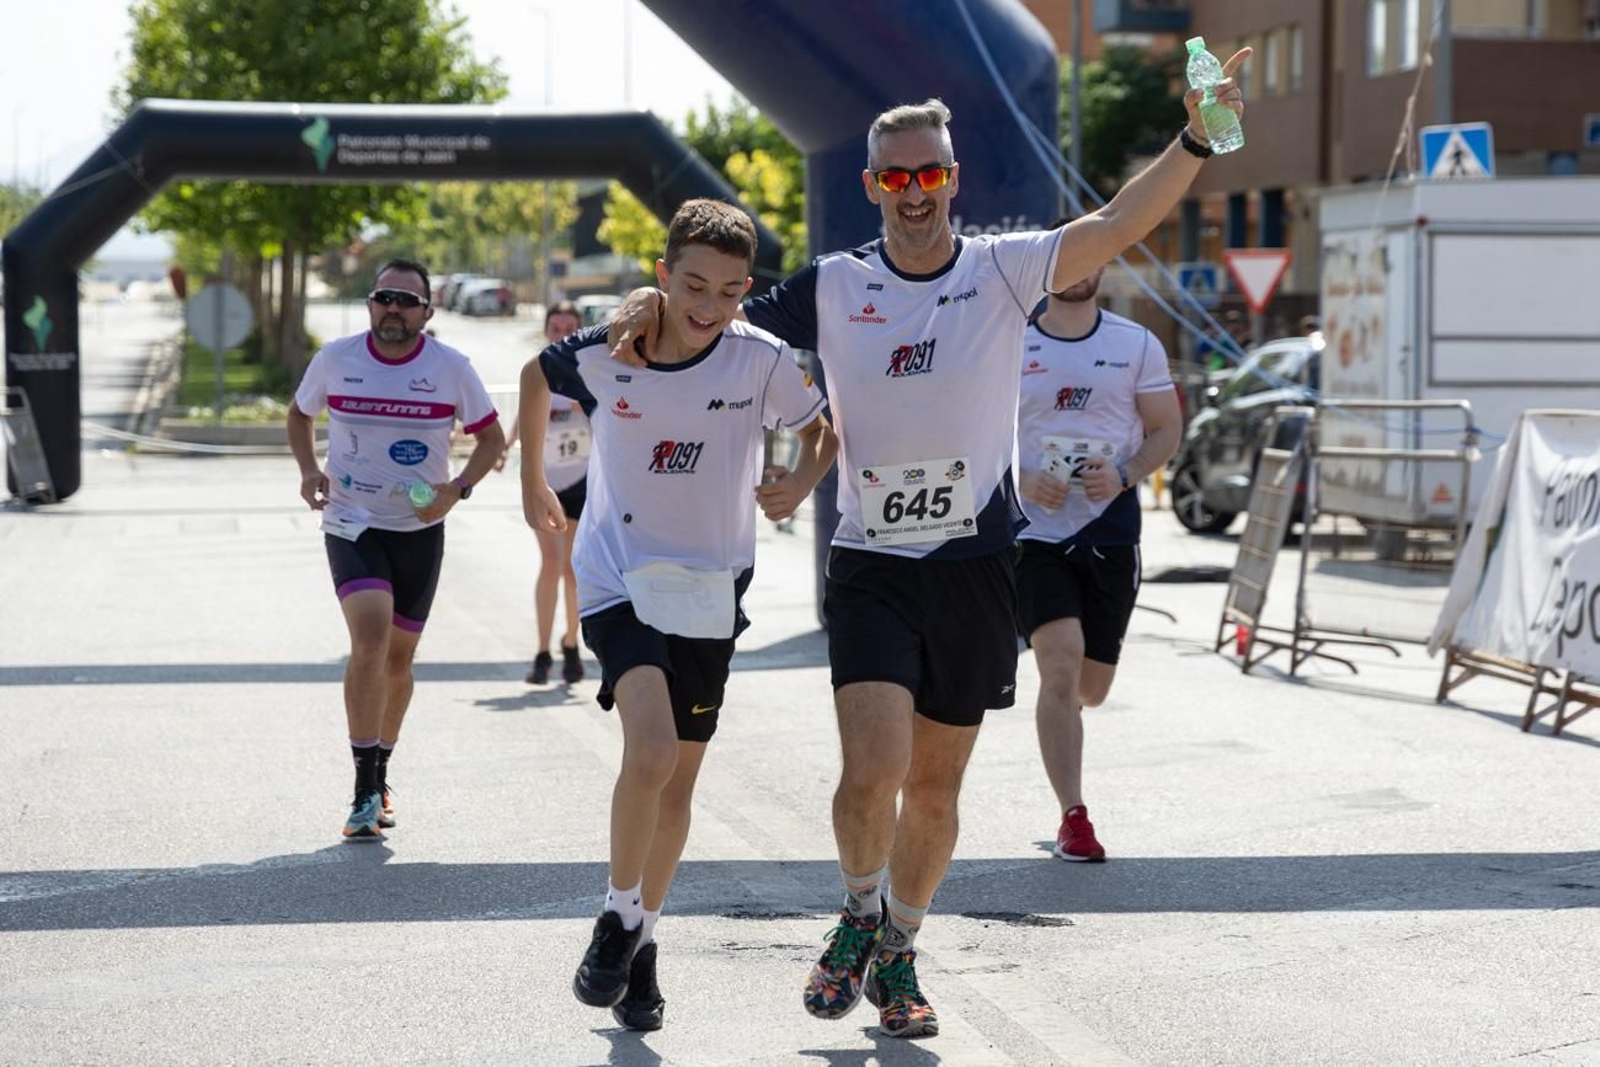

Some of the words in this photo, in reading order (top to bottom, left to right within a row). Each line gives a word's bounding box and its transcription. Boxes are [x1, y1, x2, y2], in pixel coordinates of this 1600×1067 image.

[338, 134, 402, 149] Patronato
[404, 134, 468, 149] Municipal
[471, 135, 491, 149] de
[338, 149, 399, 165] Deportes
[402, 149, 420, 164] de
[848, 315, 886, 324] Santander
[611, 408, 642, 419] tander
[883, 485, 953, 524] 645
